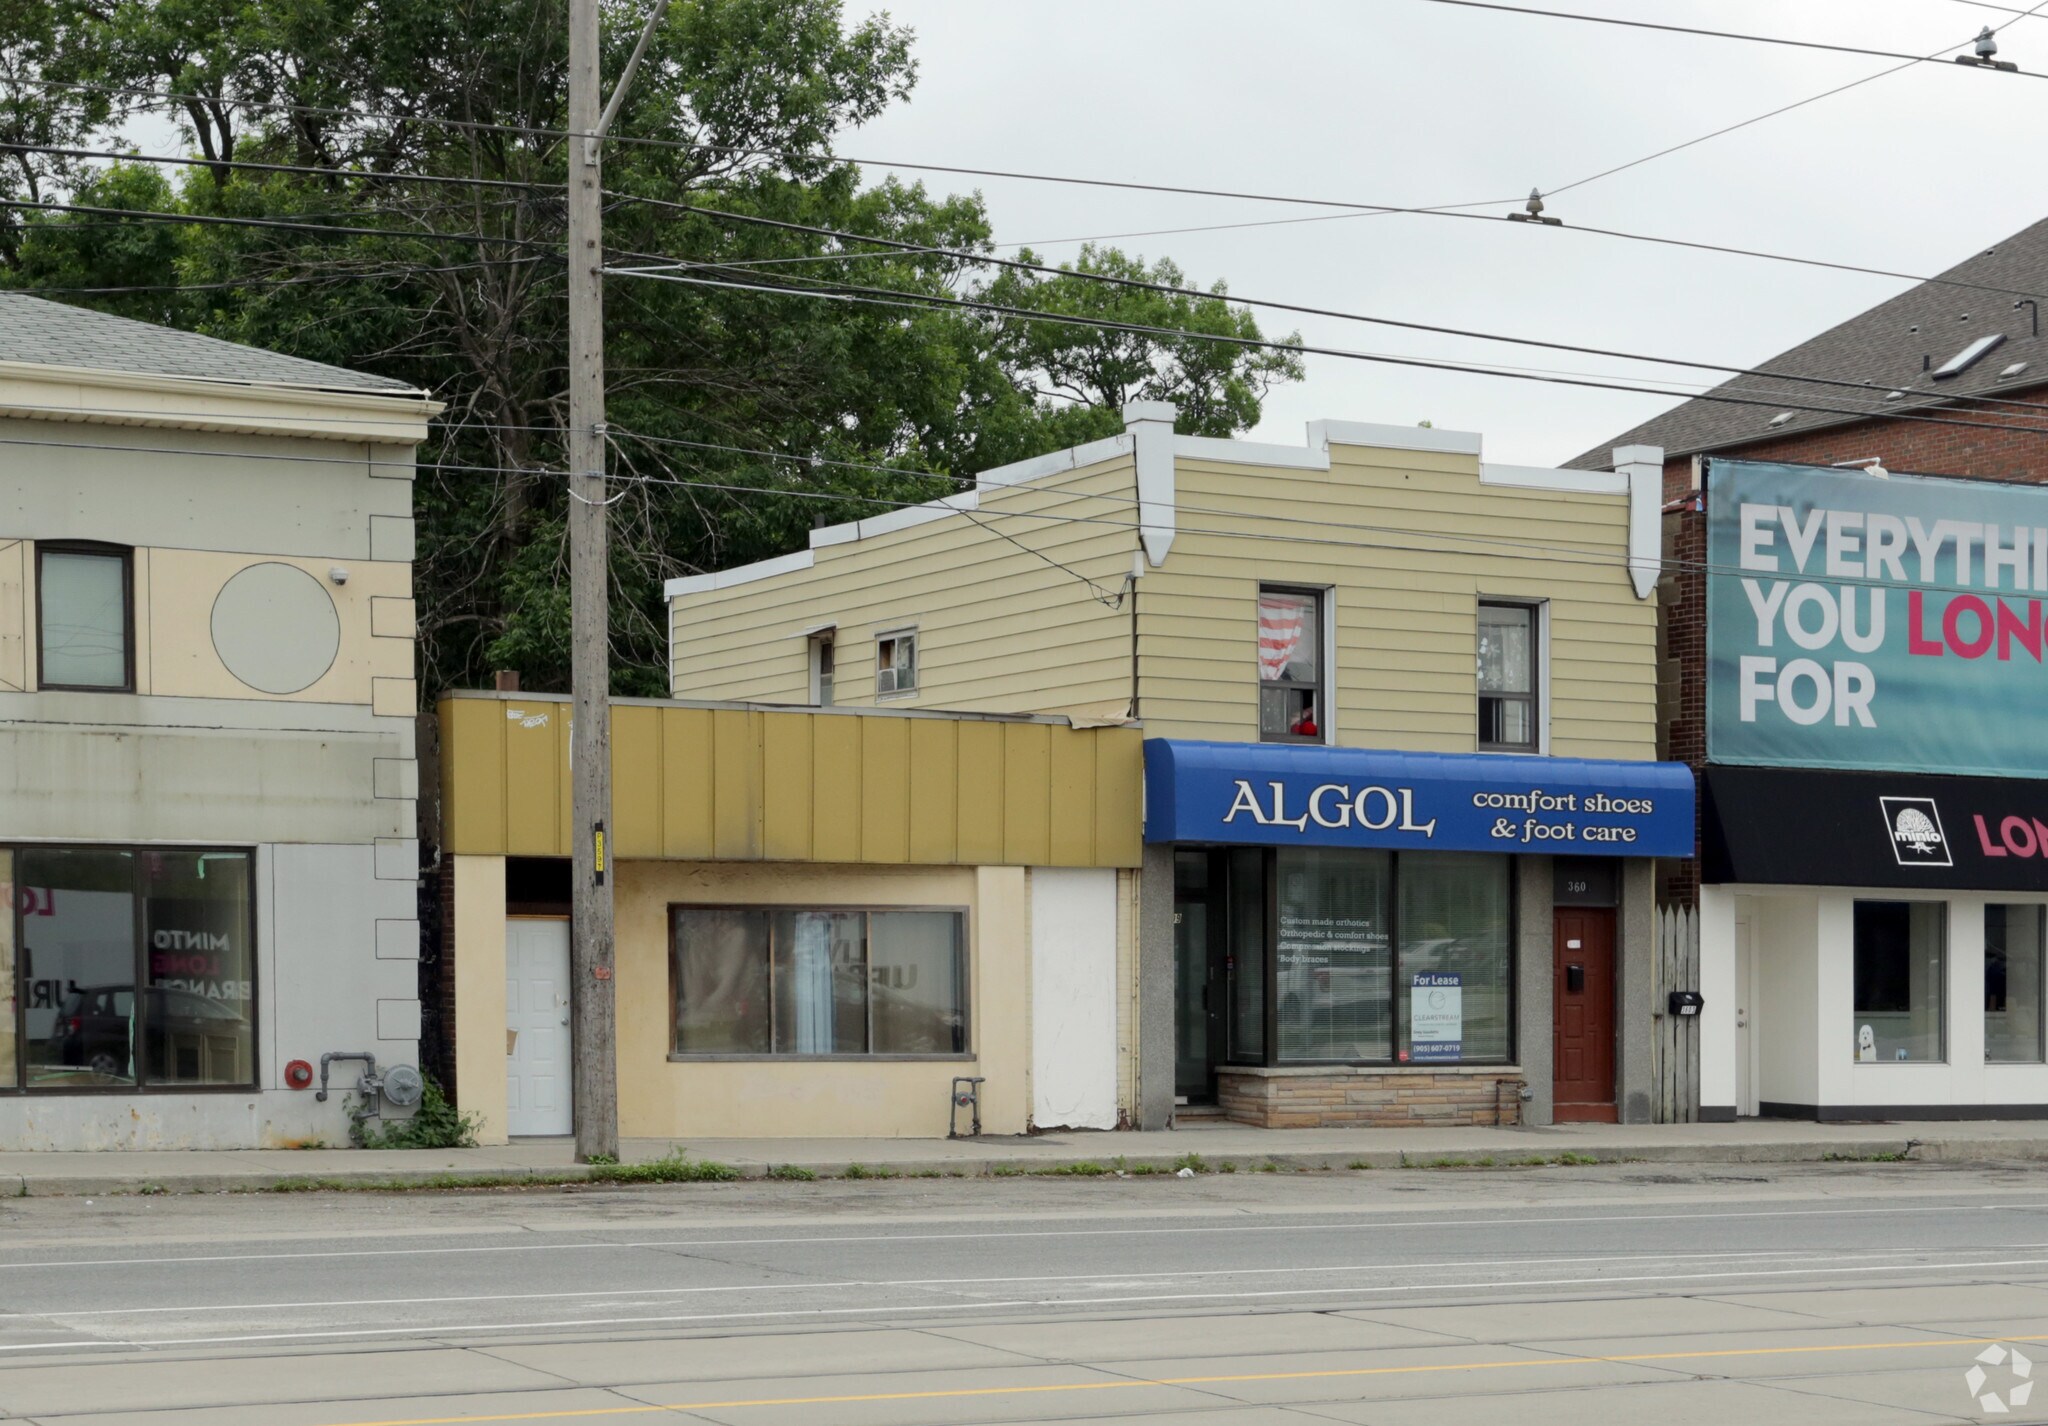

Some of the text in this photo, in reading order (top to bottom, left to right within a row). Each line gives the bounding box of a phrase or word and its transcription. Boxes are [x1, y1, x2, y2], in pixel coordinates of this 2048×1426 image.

[1740, 503, 2048, 591] EVERYTHI
[1741, 578, 2048, 664] YOU LON
[1740, 655, 1877, 728] FOR
[1472, 789, 1653, 814] comfort shoes
[1221, 779, 1436, 838] ALGOL
[1490, 818, 1637, 843] & foot care
[1894, 831, 1942, 843] minto
[1568, 881, 1586, 893] 360
[1280, 916, 1370, 927] Custom made orthotics
[1280, 929, 1389, 940] Orthopedic & comfort shoes
[1333, 943, 1371, 954] stockings
[1280, 954, 1329, 964] Body braces
[1413, 975, 1459, 986] For Lease
[1413, 1044, 1430, 1053] (905)
